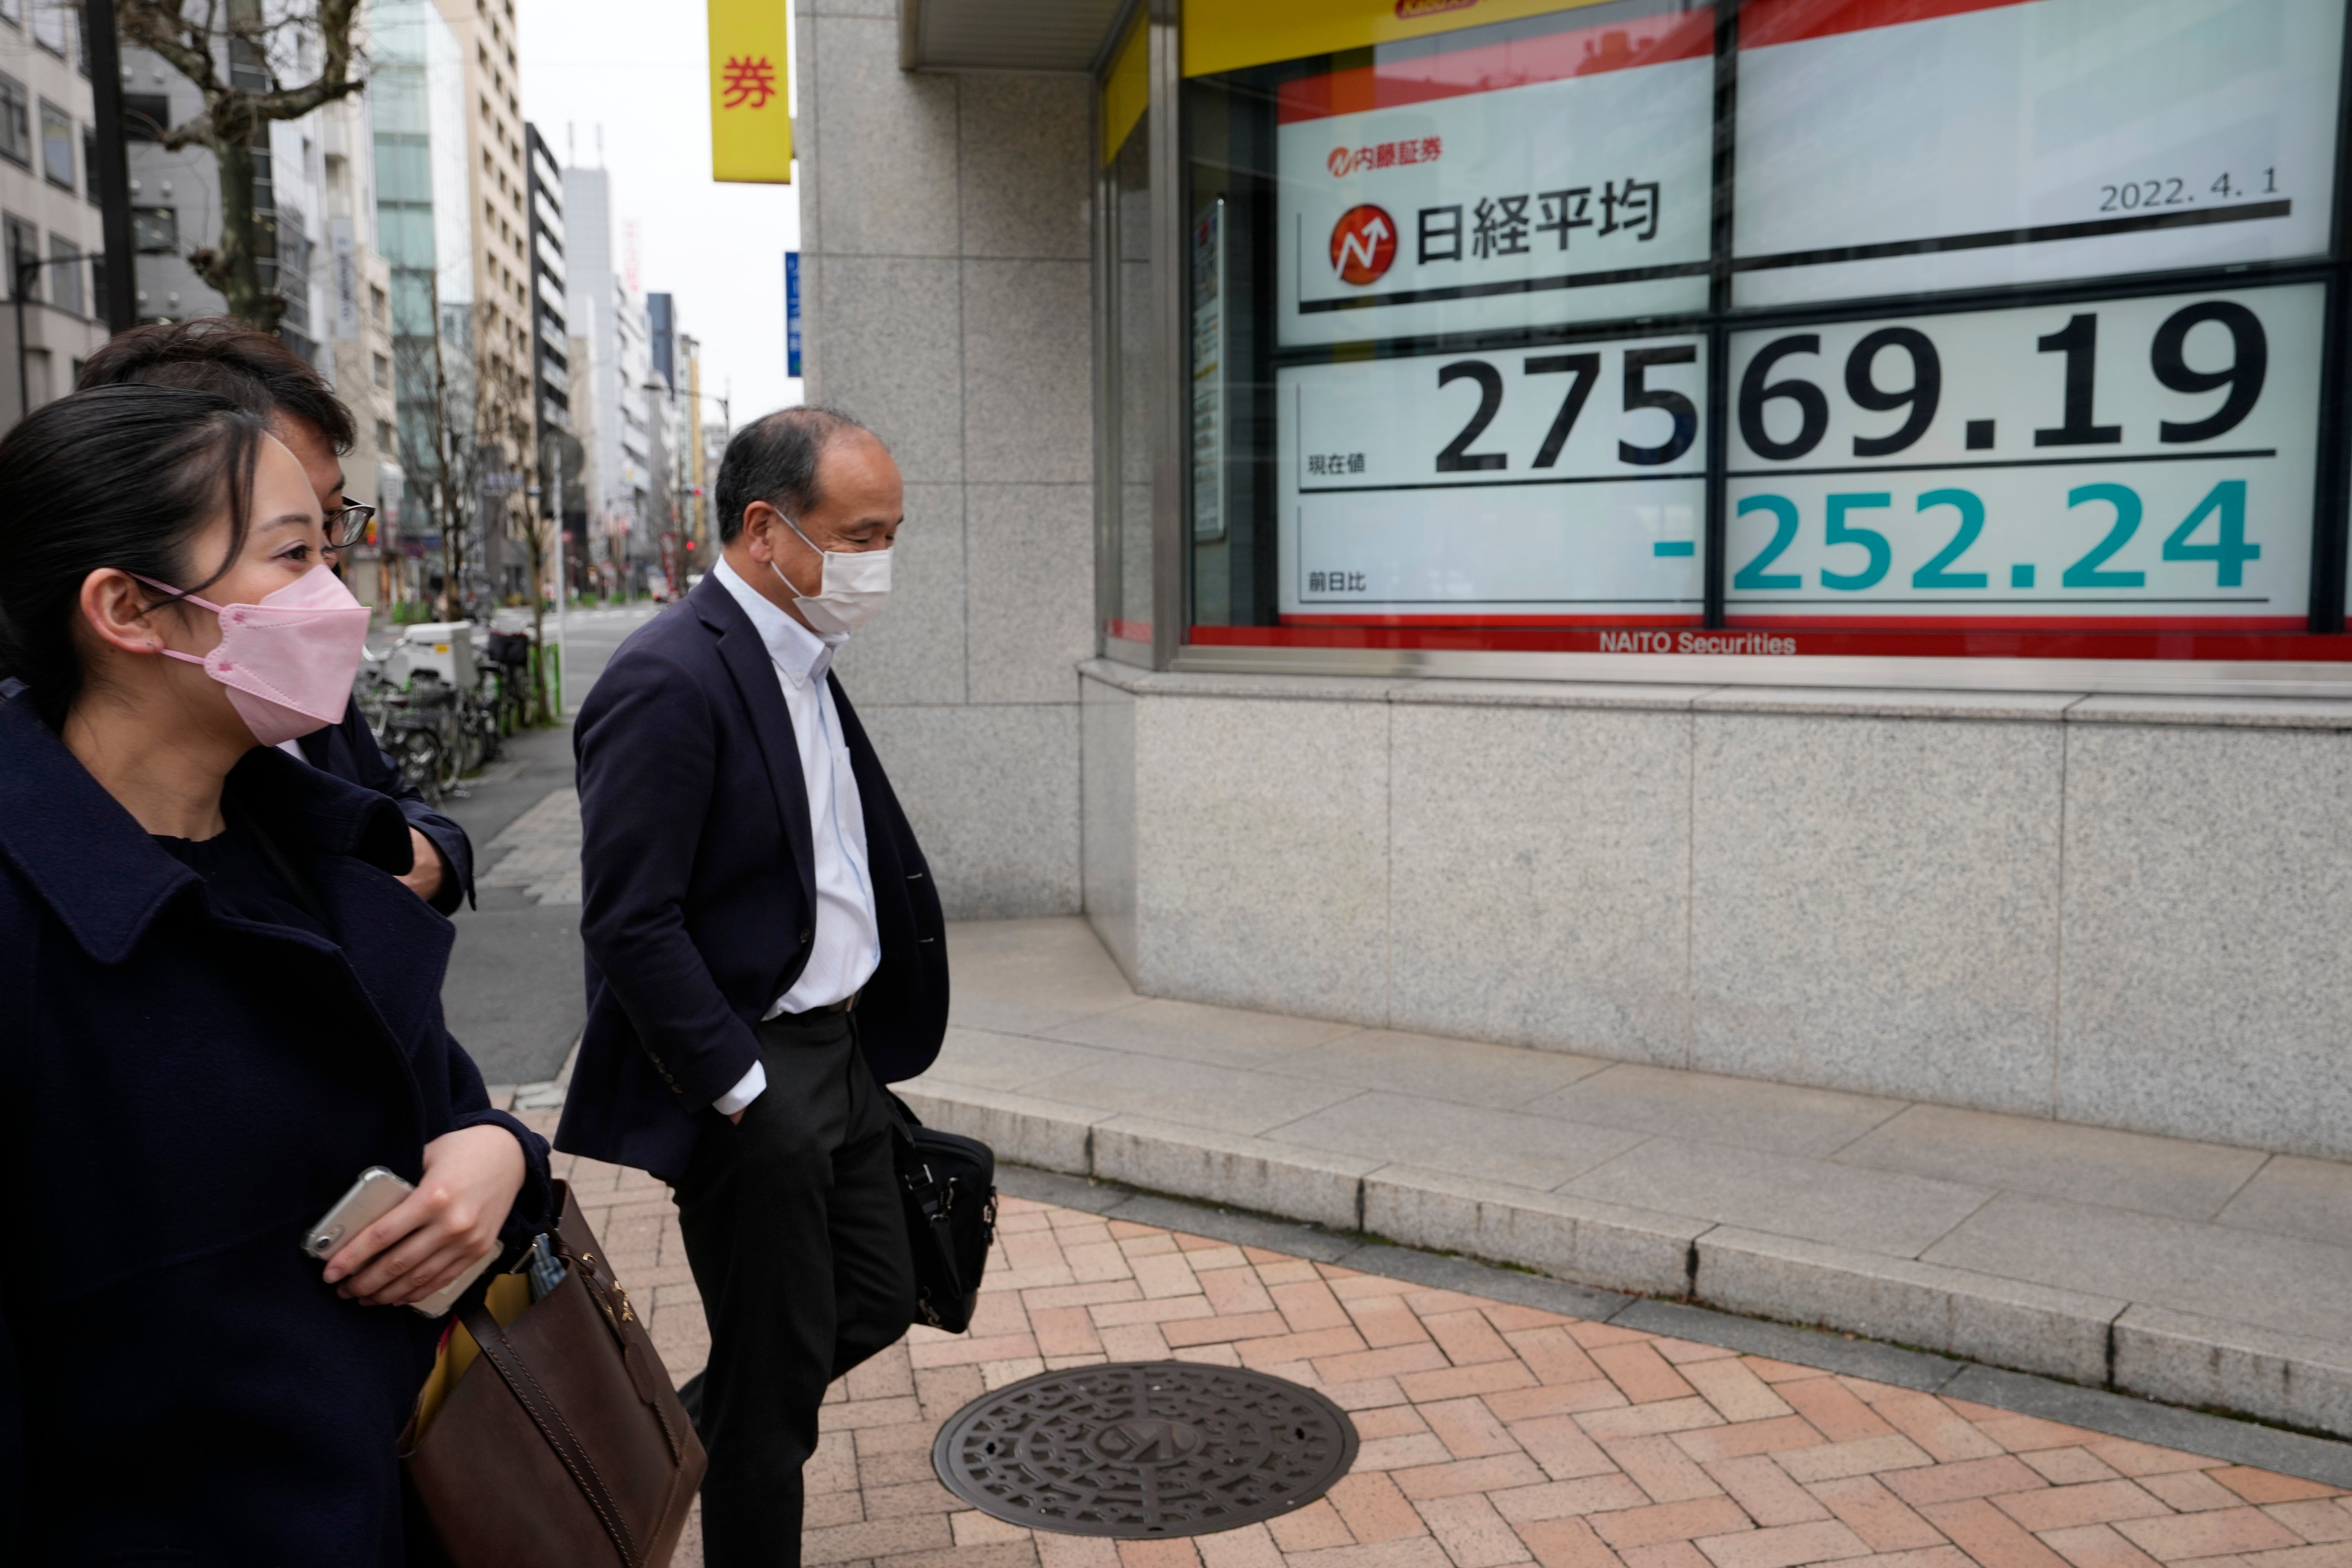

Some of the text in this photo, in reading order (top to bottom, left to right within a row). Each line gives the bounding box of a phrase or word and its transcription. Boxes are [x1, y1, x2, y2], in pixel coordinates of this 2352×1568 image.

[723, 57, 775, 108] 券
[1354, 136, 1442, 171] 内藤証券
[1417, 178, 1660, 266] 日経平均
[1308, 452, 1366, 475] 現在値
[1309, 571, 1367, 593] 前日比
[1599, 631, 1797, 655] NAITO Securities
